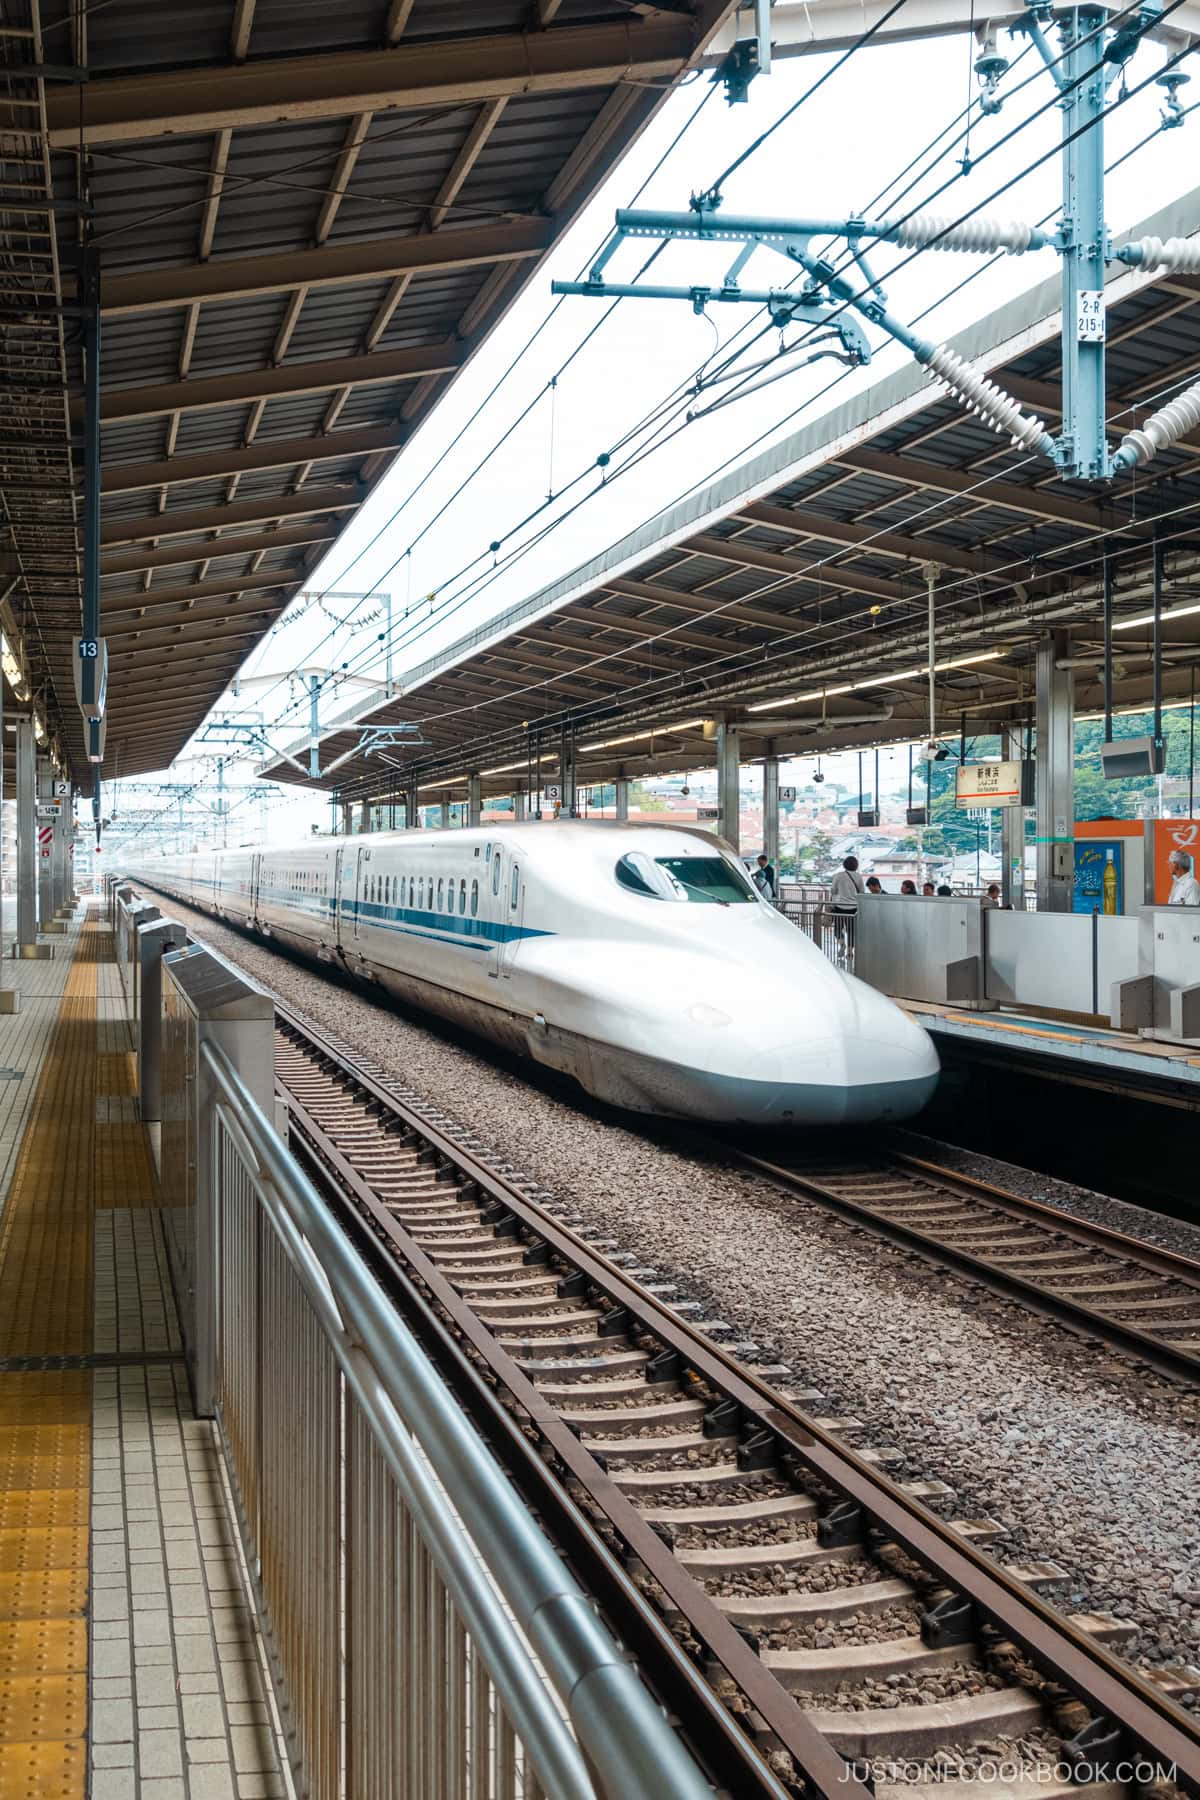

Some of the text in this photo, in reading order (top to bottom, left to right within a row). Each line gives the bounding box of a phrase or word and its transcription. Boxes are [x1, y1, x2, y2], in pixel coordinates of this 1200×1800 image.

[80, 642, 98, 657] 13
[59, 784, 66, 794] 2
[550, 787, 558, 797] 3
[783, 789, 790, 798] 4
